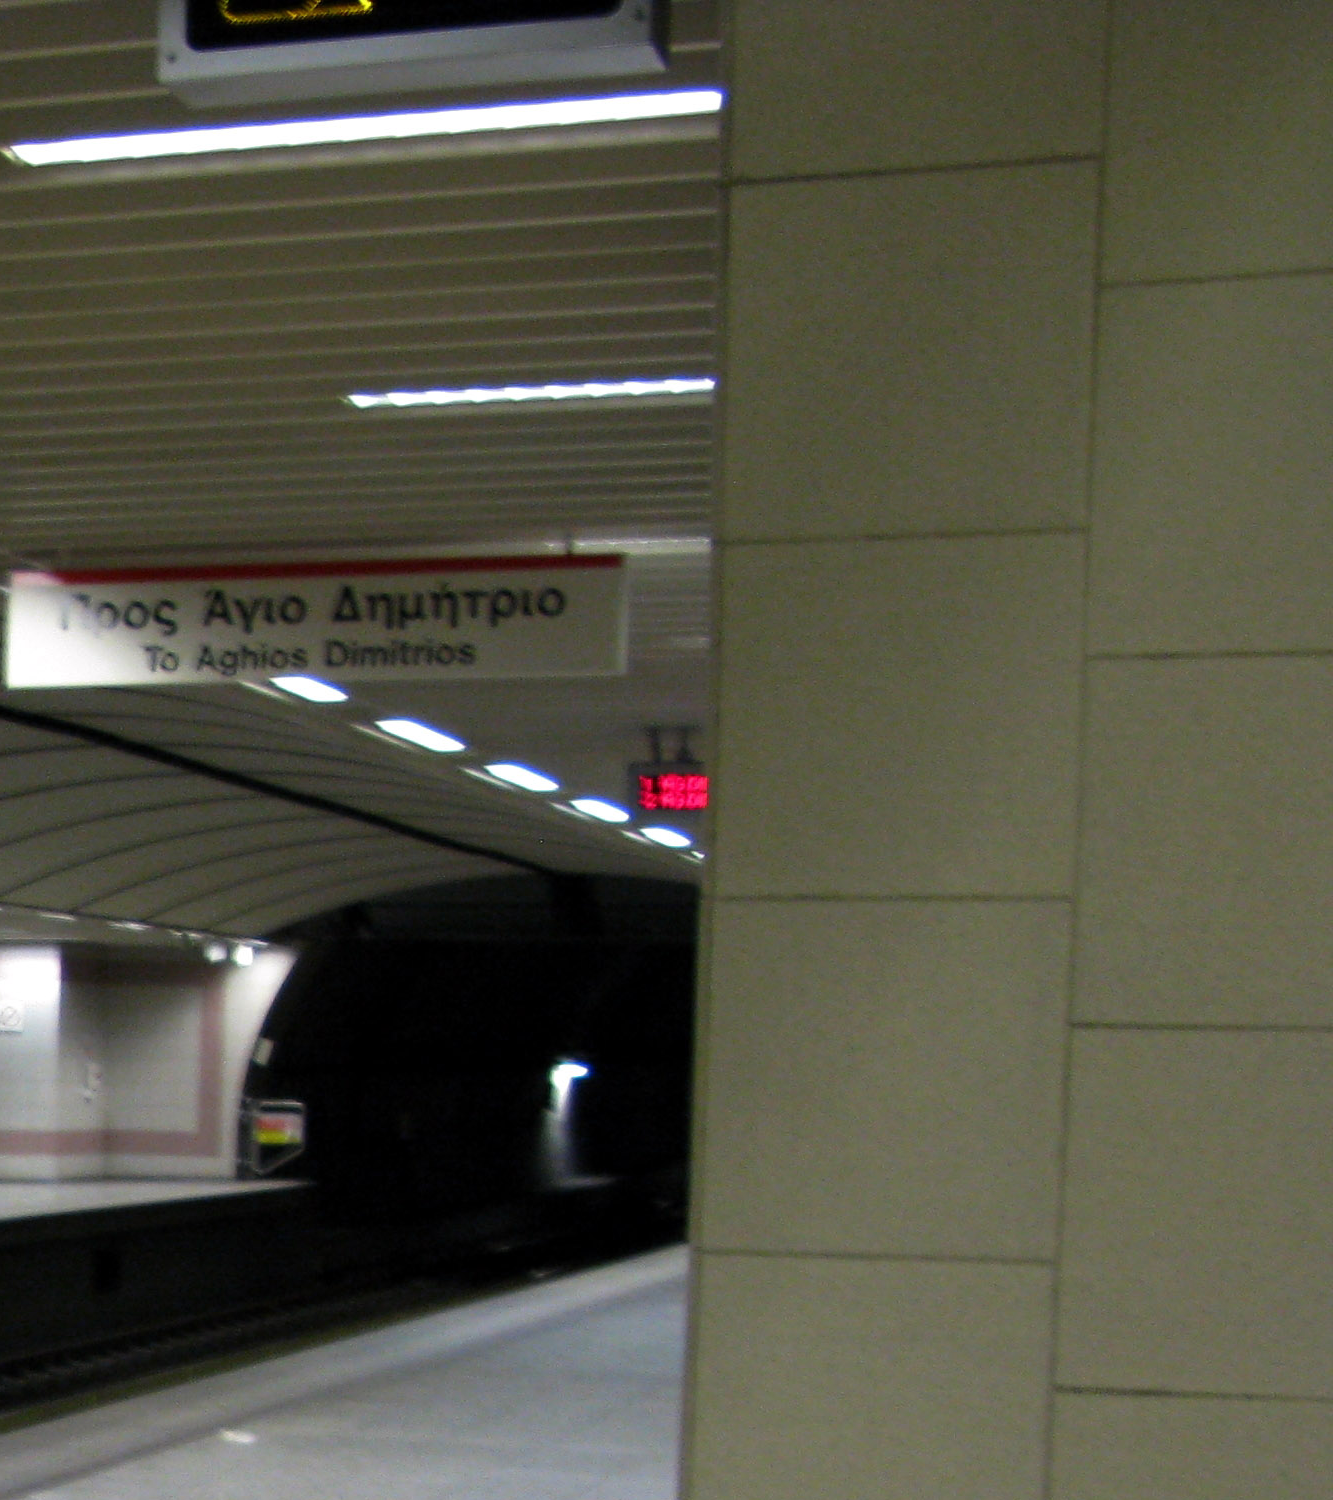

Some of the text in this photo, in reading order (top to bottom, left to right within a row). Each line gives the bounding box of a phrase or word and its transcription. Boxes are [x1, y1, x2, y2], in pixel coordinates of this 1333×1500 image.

[331, 583, 568, 631] Δημήτριο
[144, 638, 477, 677] To Aghios Dimitrios
